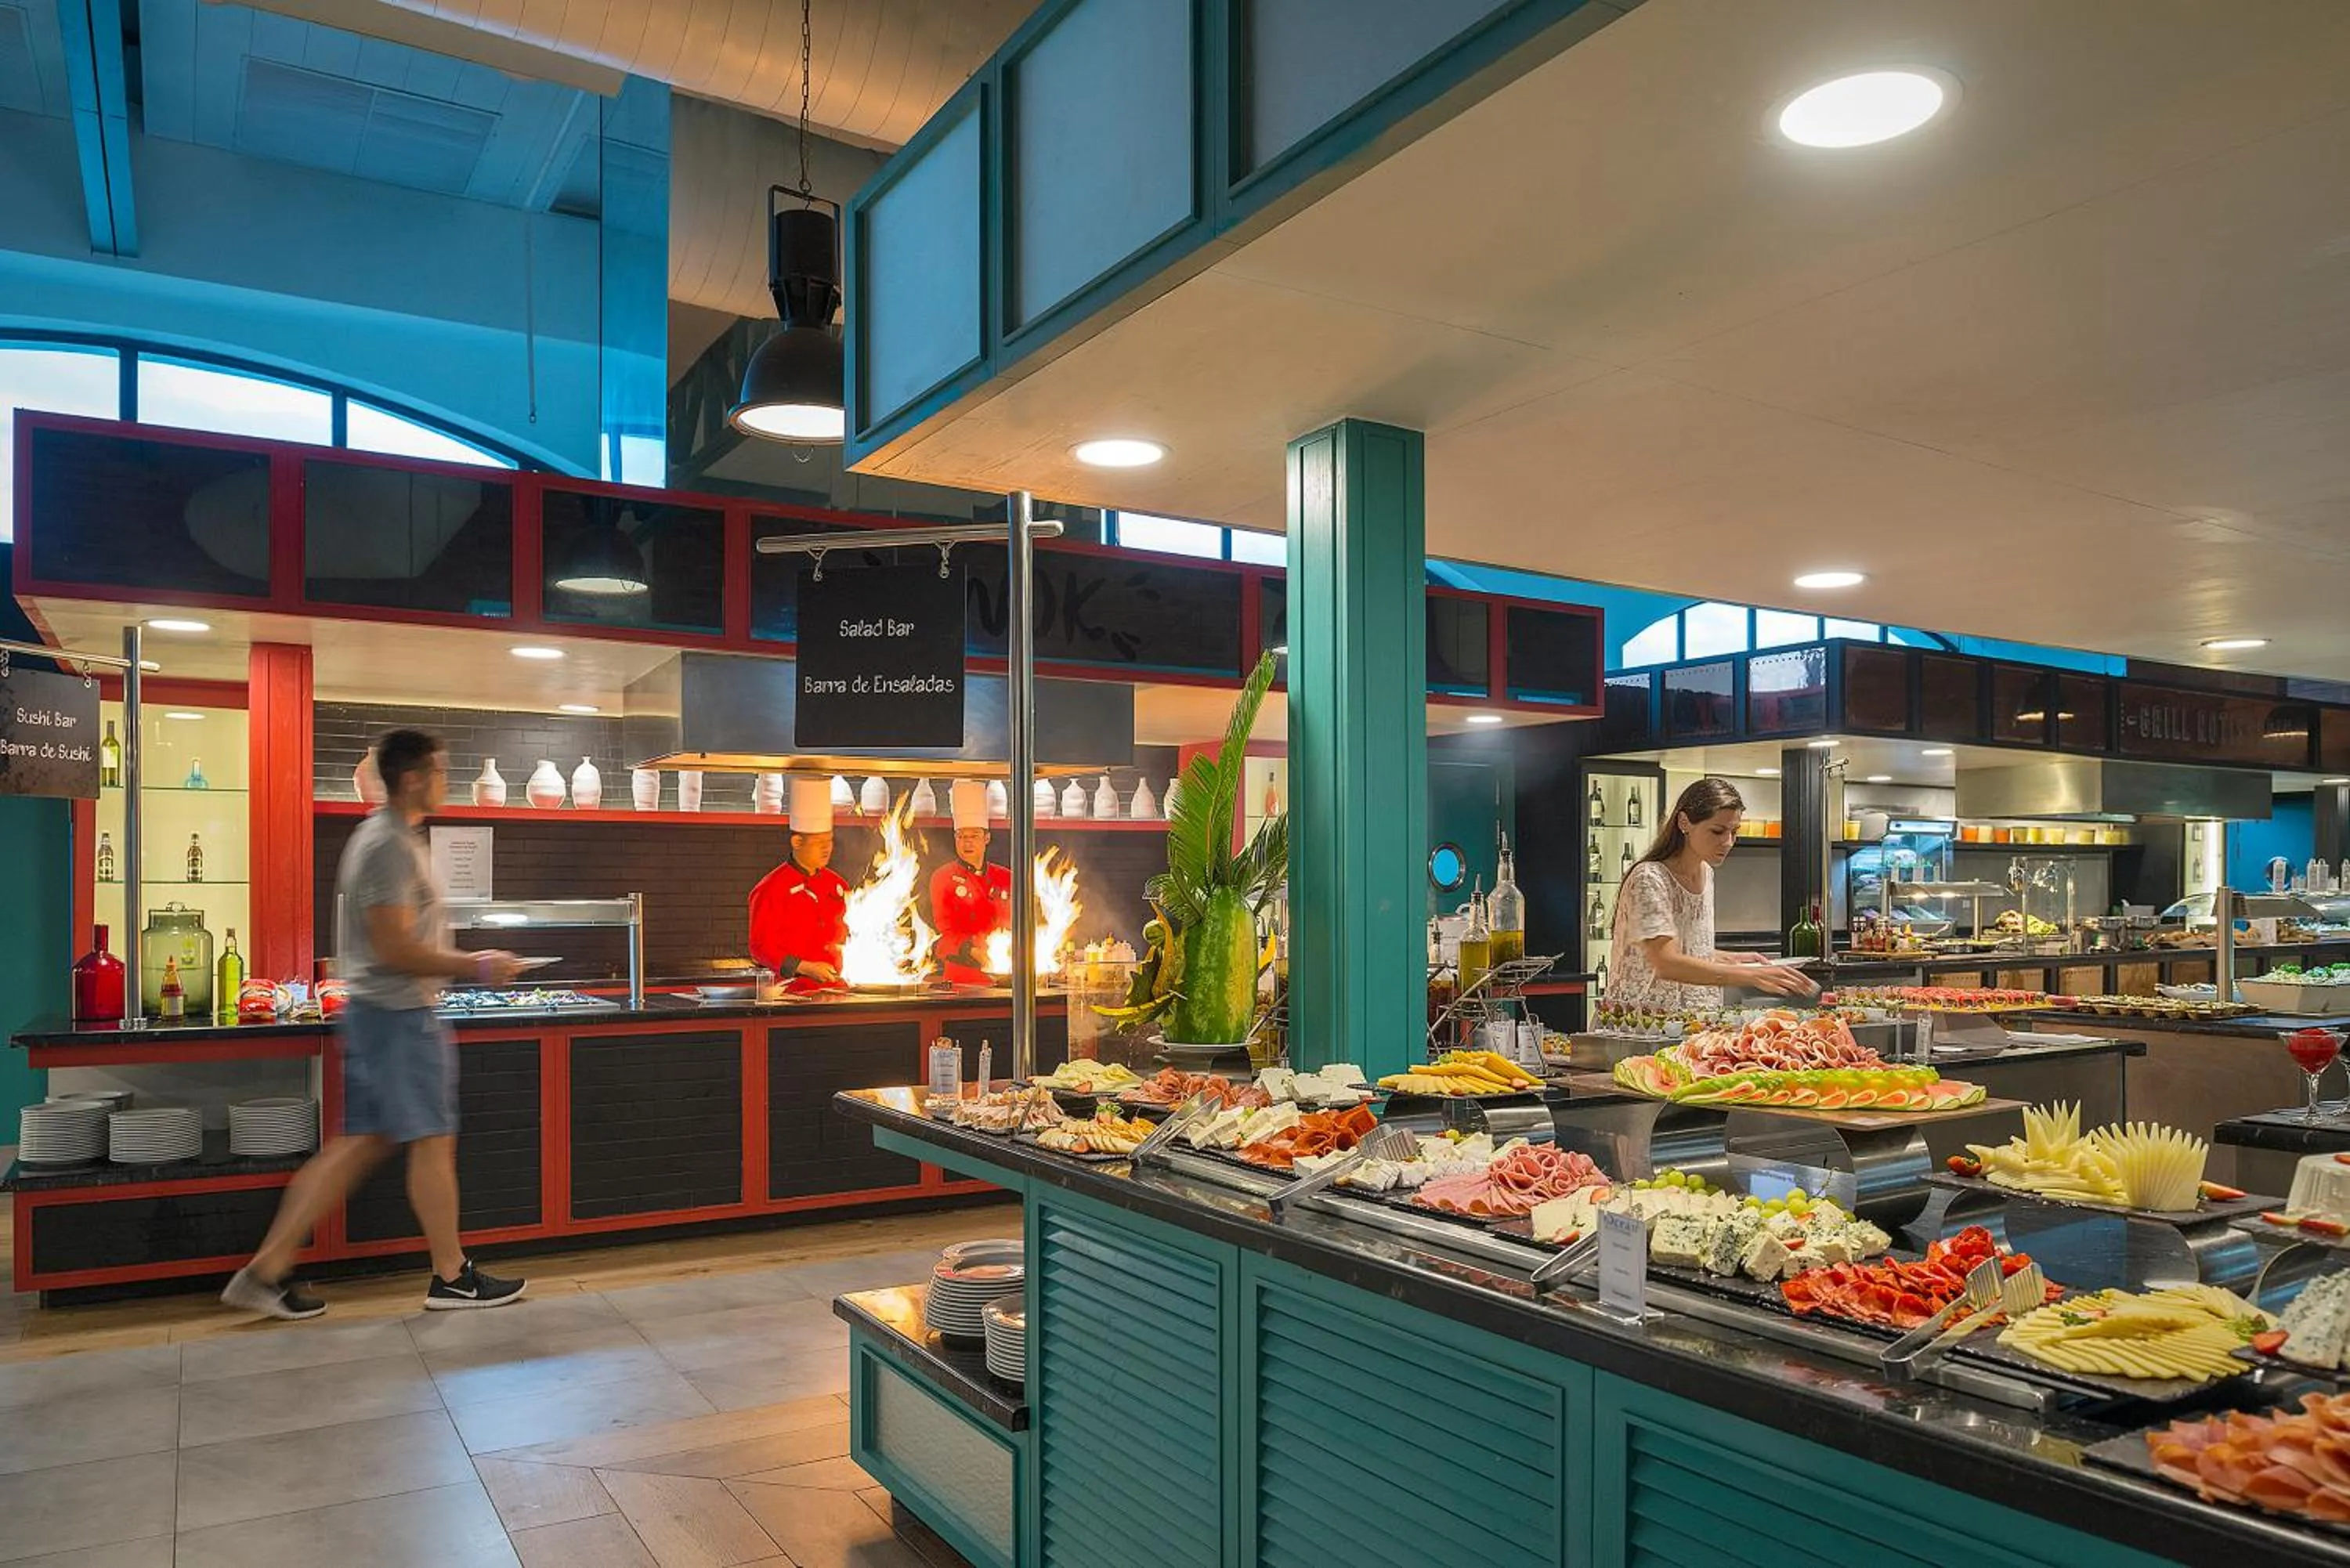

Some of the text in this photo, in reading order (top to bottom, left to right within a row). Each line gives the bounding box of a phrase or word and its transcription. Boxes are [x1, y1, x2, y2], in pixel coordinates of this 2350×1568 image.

[839, 617, 916, 638] Salad Bar
[804, 673, 956, 694] Barra de Ensaladas
[16, 707, 77, 728] Sushi Bar
[0, 739, 92, 762] Barra de Sushi
